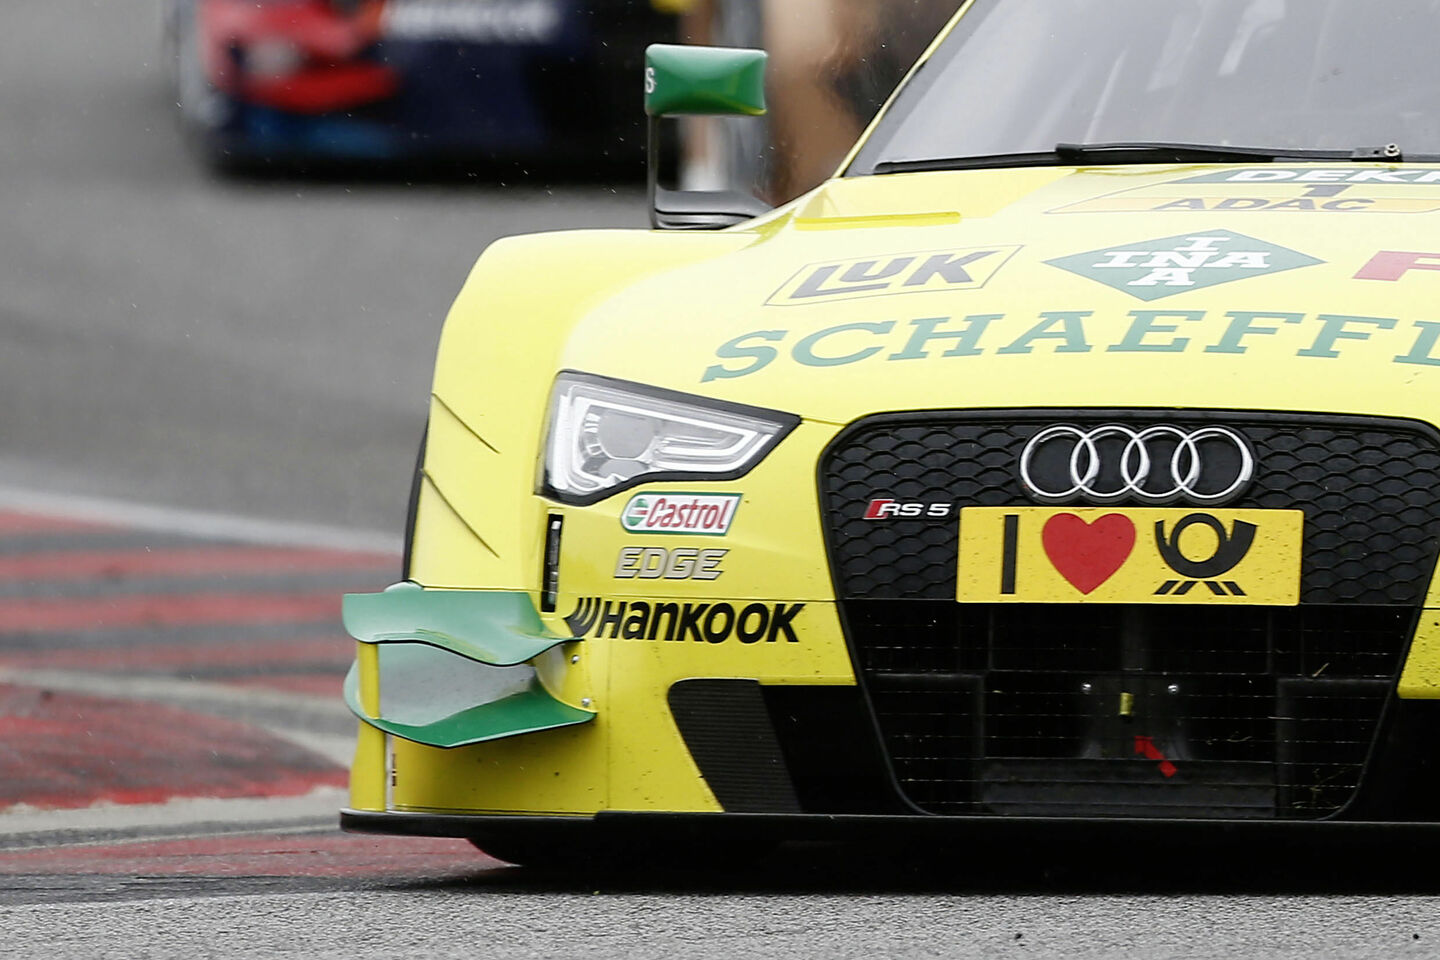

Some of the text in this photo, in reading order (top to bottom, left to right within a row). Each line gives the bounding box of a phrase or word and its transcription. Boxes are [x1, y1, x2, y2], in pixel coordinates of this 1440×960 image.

[1302, 184, 1352, 197] 1
[1151, 197, 1376, 212] ADAC
[646, 497, 733, 530] Castrol
[864, 499, 952, 519] RS 5
[613, 546, 732, 581] EDGE
